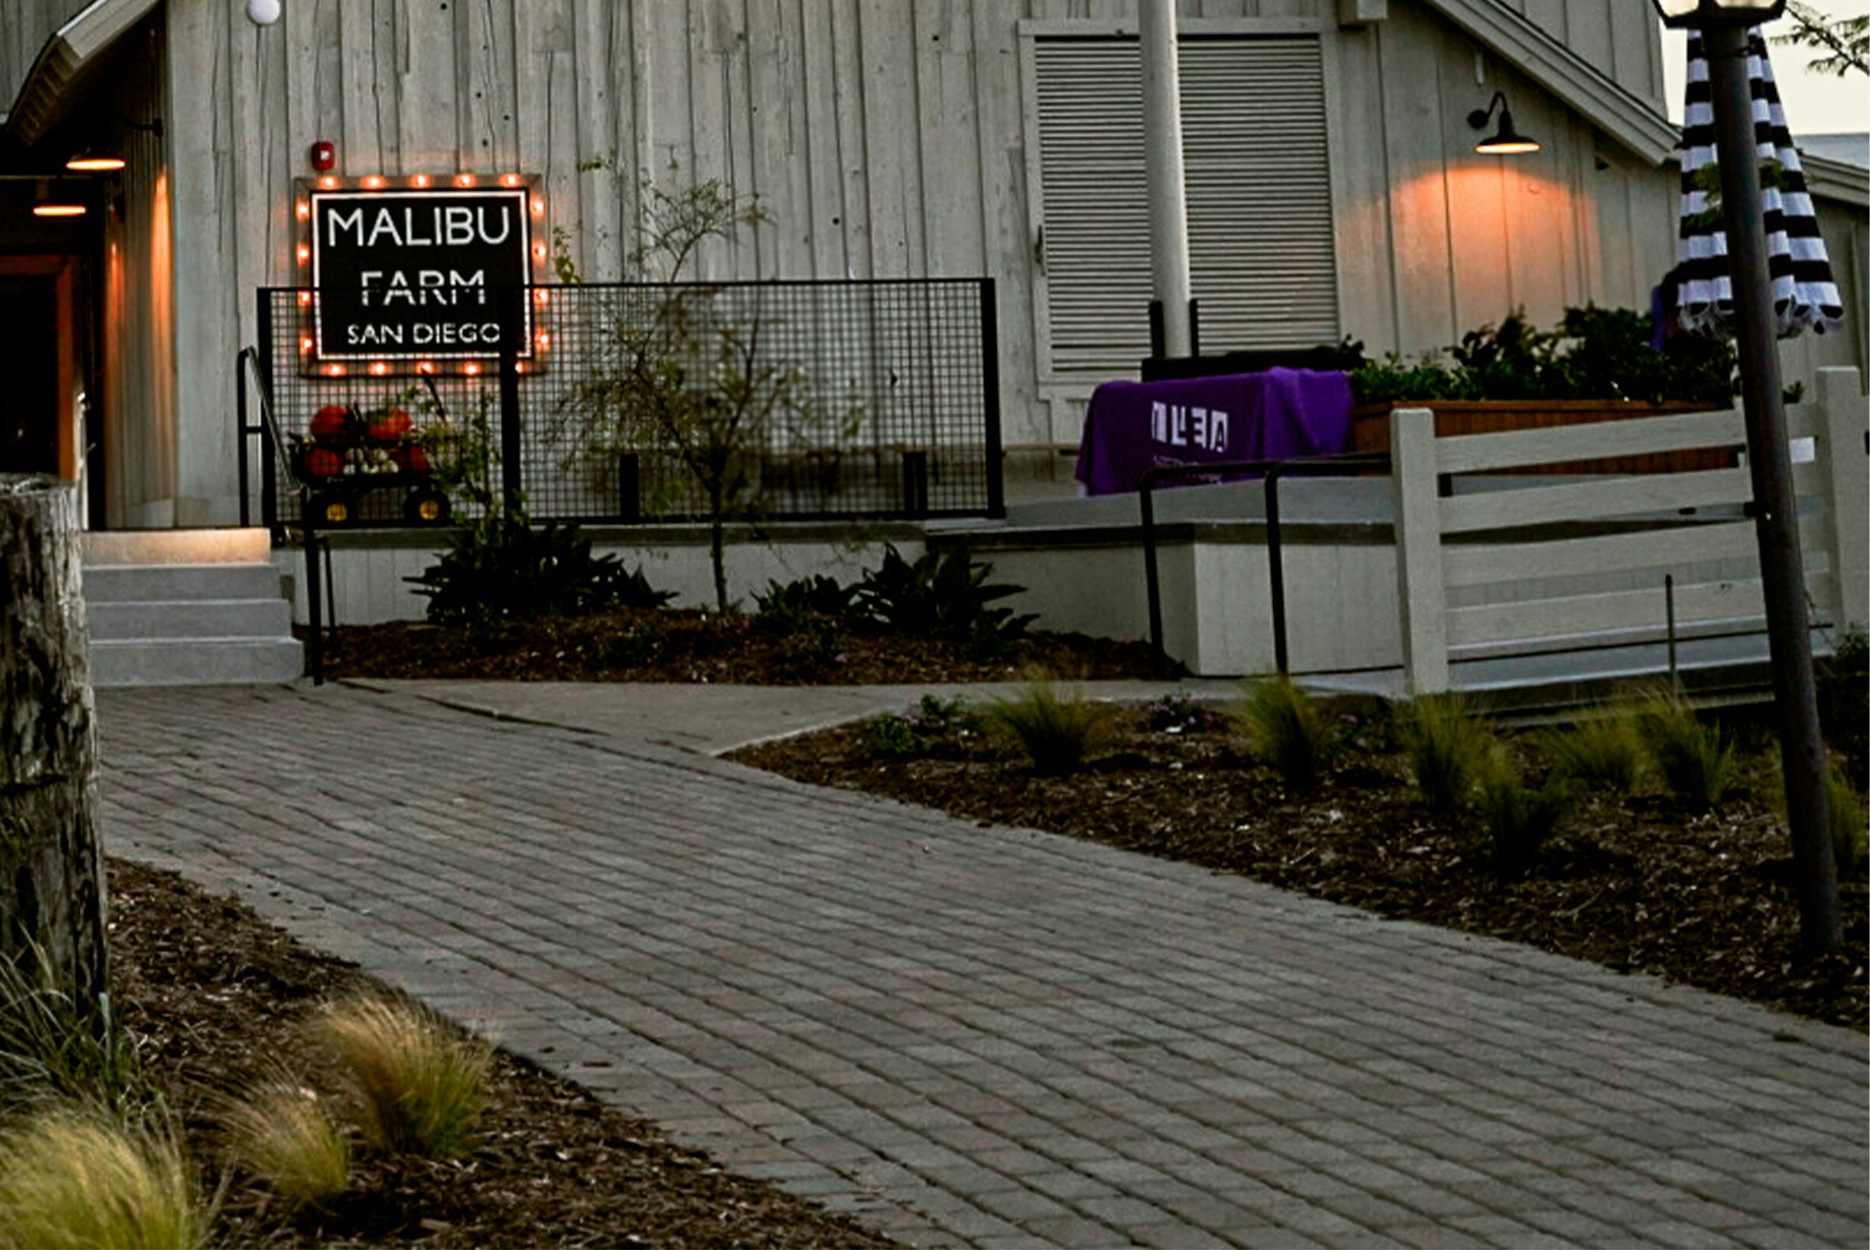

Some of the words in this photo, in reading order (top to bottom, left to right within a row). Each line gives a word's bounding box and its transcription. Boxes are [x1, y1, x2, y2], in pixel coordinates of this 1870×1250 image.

[328, 206, 510, 247] MALIBU
[361, 270, 486, 306] FARM
[347, 323, 403, 344] SAN
[413, 323, 500, 344] DIEGO
